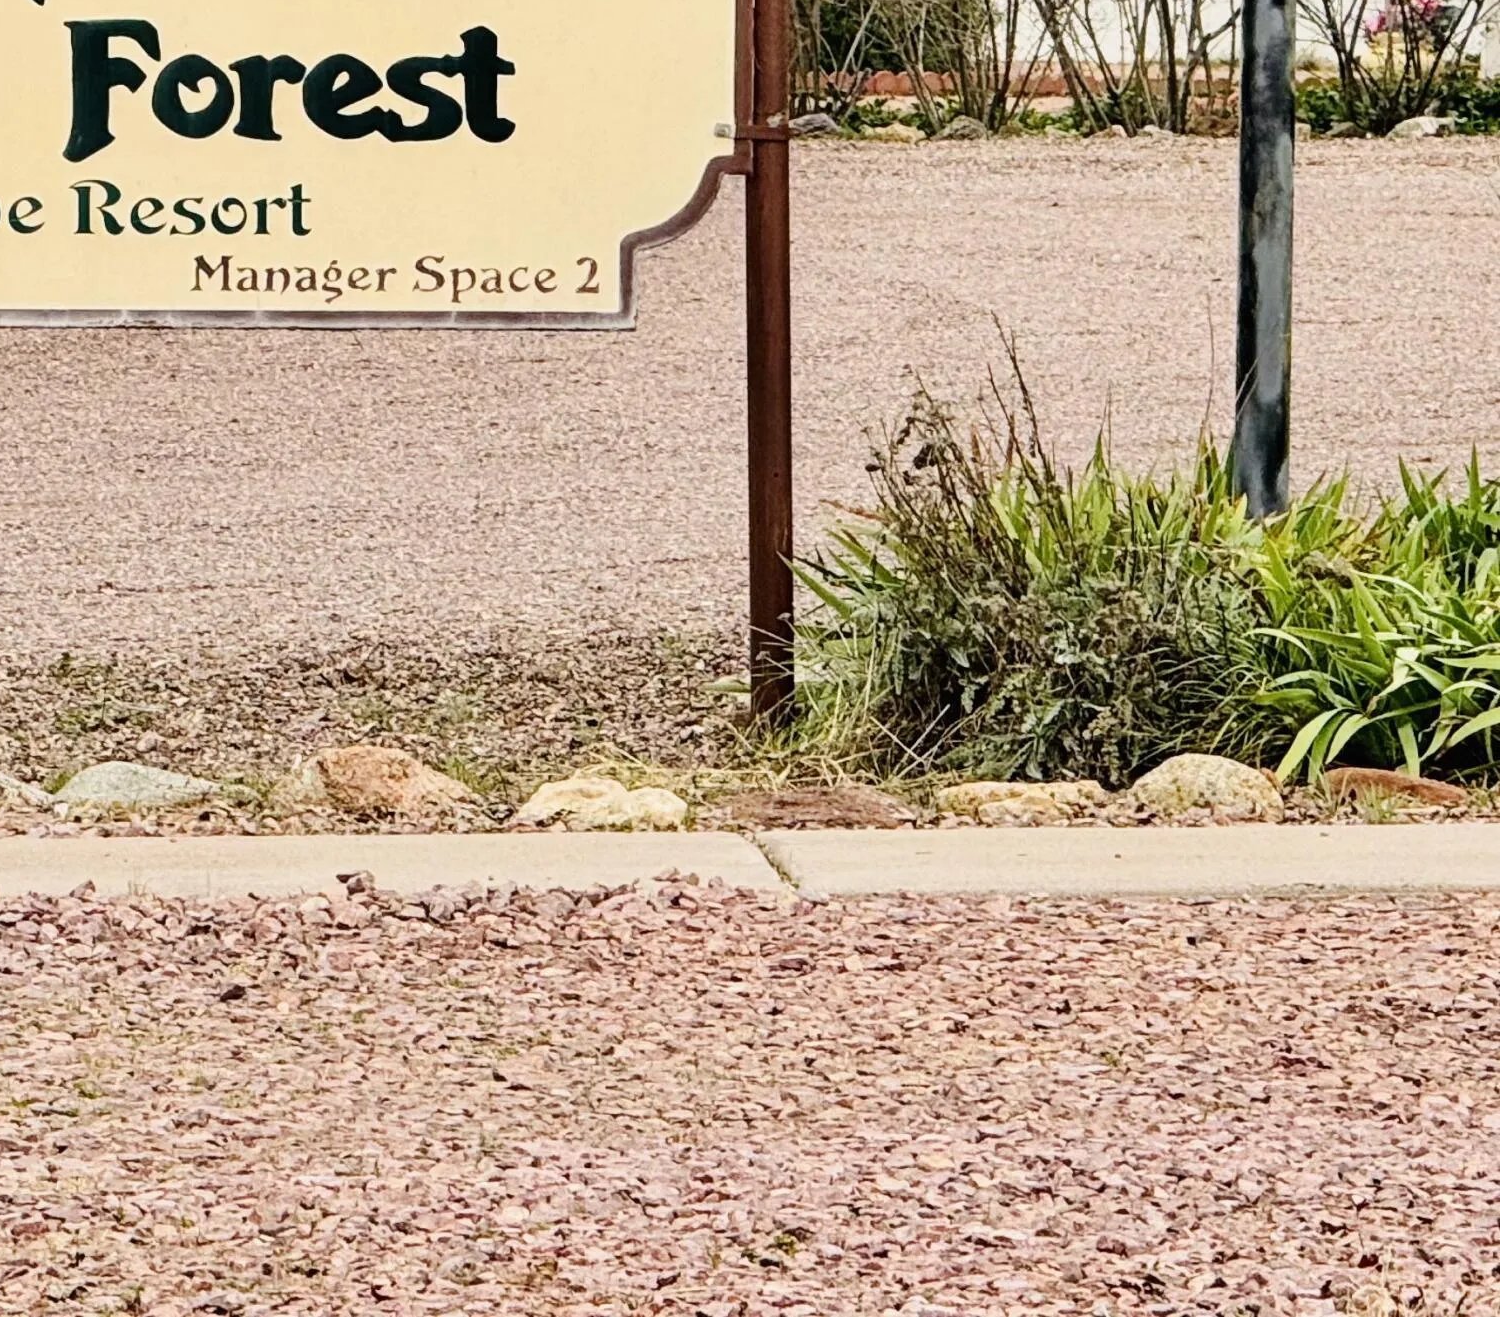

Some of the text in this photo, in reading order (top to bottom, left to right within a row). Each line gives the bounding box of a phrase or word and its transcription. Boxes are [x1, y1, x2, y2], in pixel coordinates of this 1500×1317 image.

[62, 19, 516, 162] Forest
[69, 179, 313, 237] Resort
[190, 254, 600, 304] Manager Space 2
